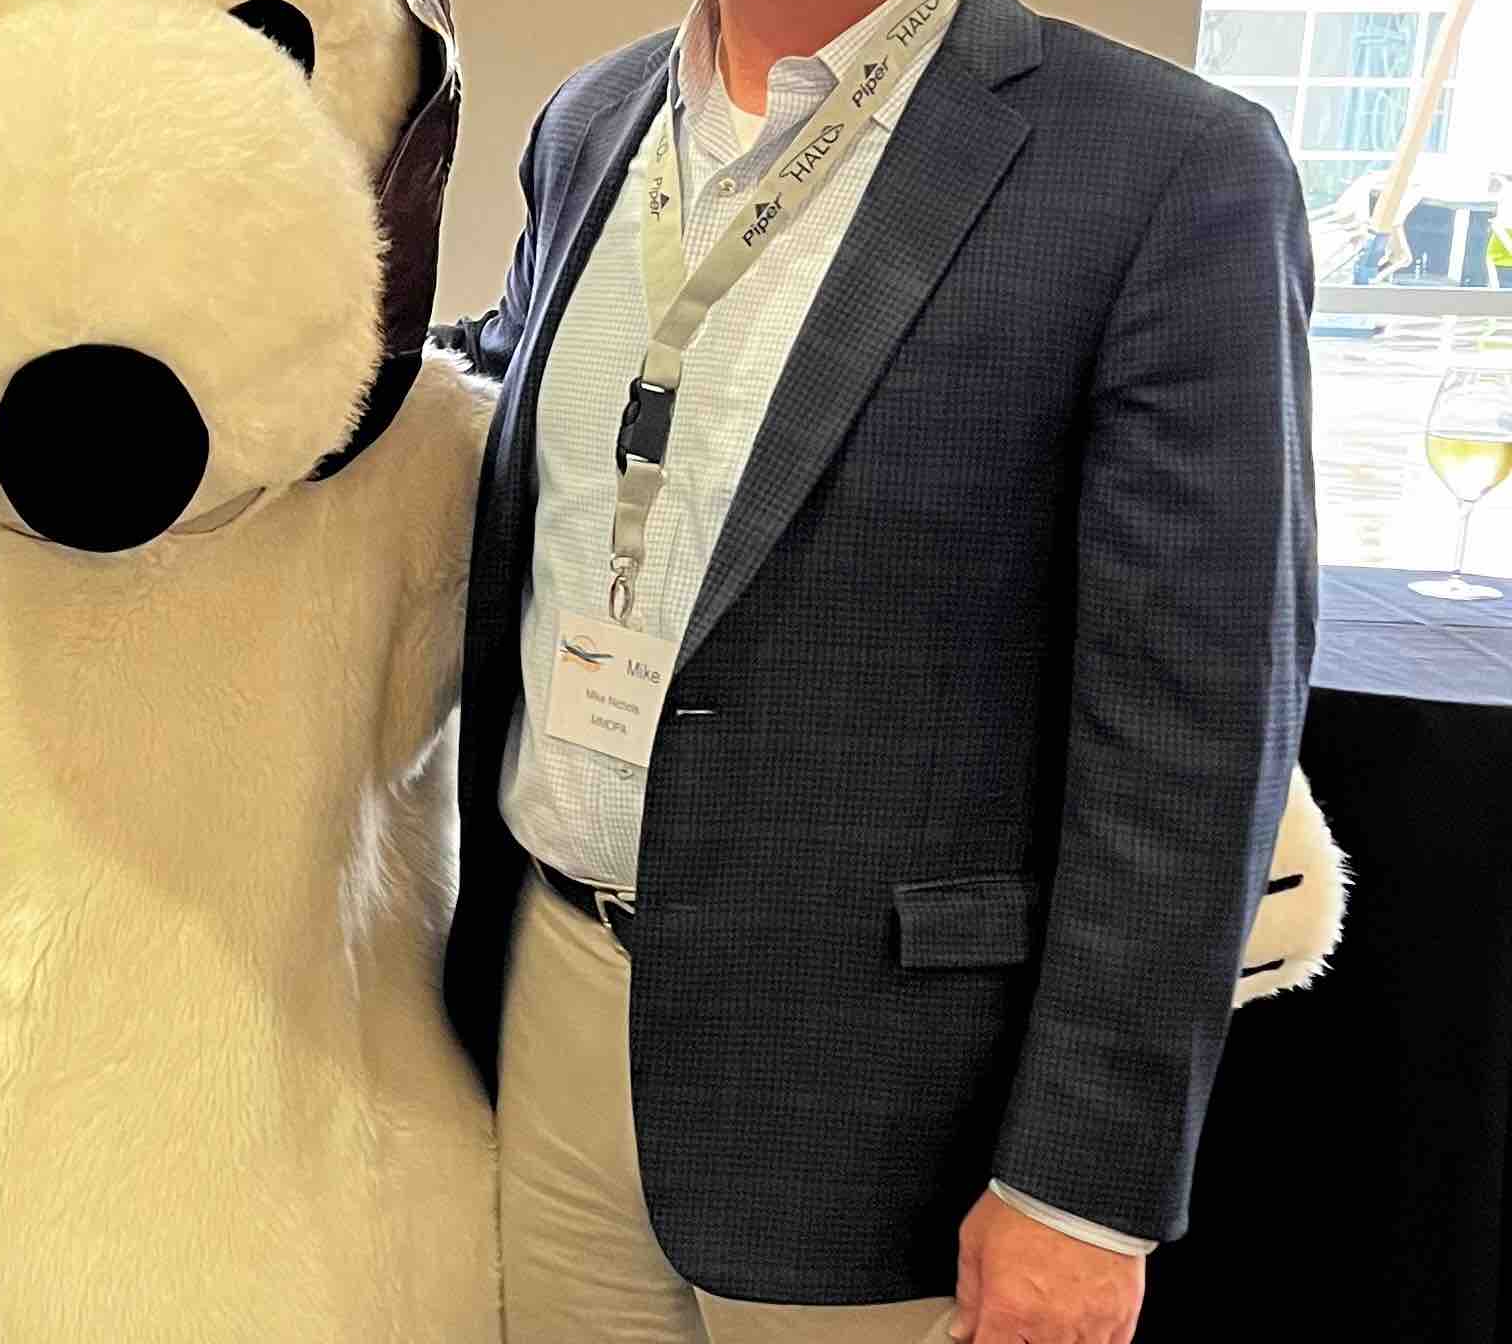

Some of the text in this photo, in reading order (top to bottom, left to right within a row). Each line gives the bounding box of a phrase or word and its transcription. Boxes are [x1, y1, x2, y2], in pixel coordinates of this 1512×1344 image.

[742, 192, 782, 247] Piper
[779, 123, 845, 183] HALO
[852, 54, 889, 108] Piper
[648, 176, 664, 223] Piper
[626, 658, 661, 685] Mike
